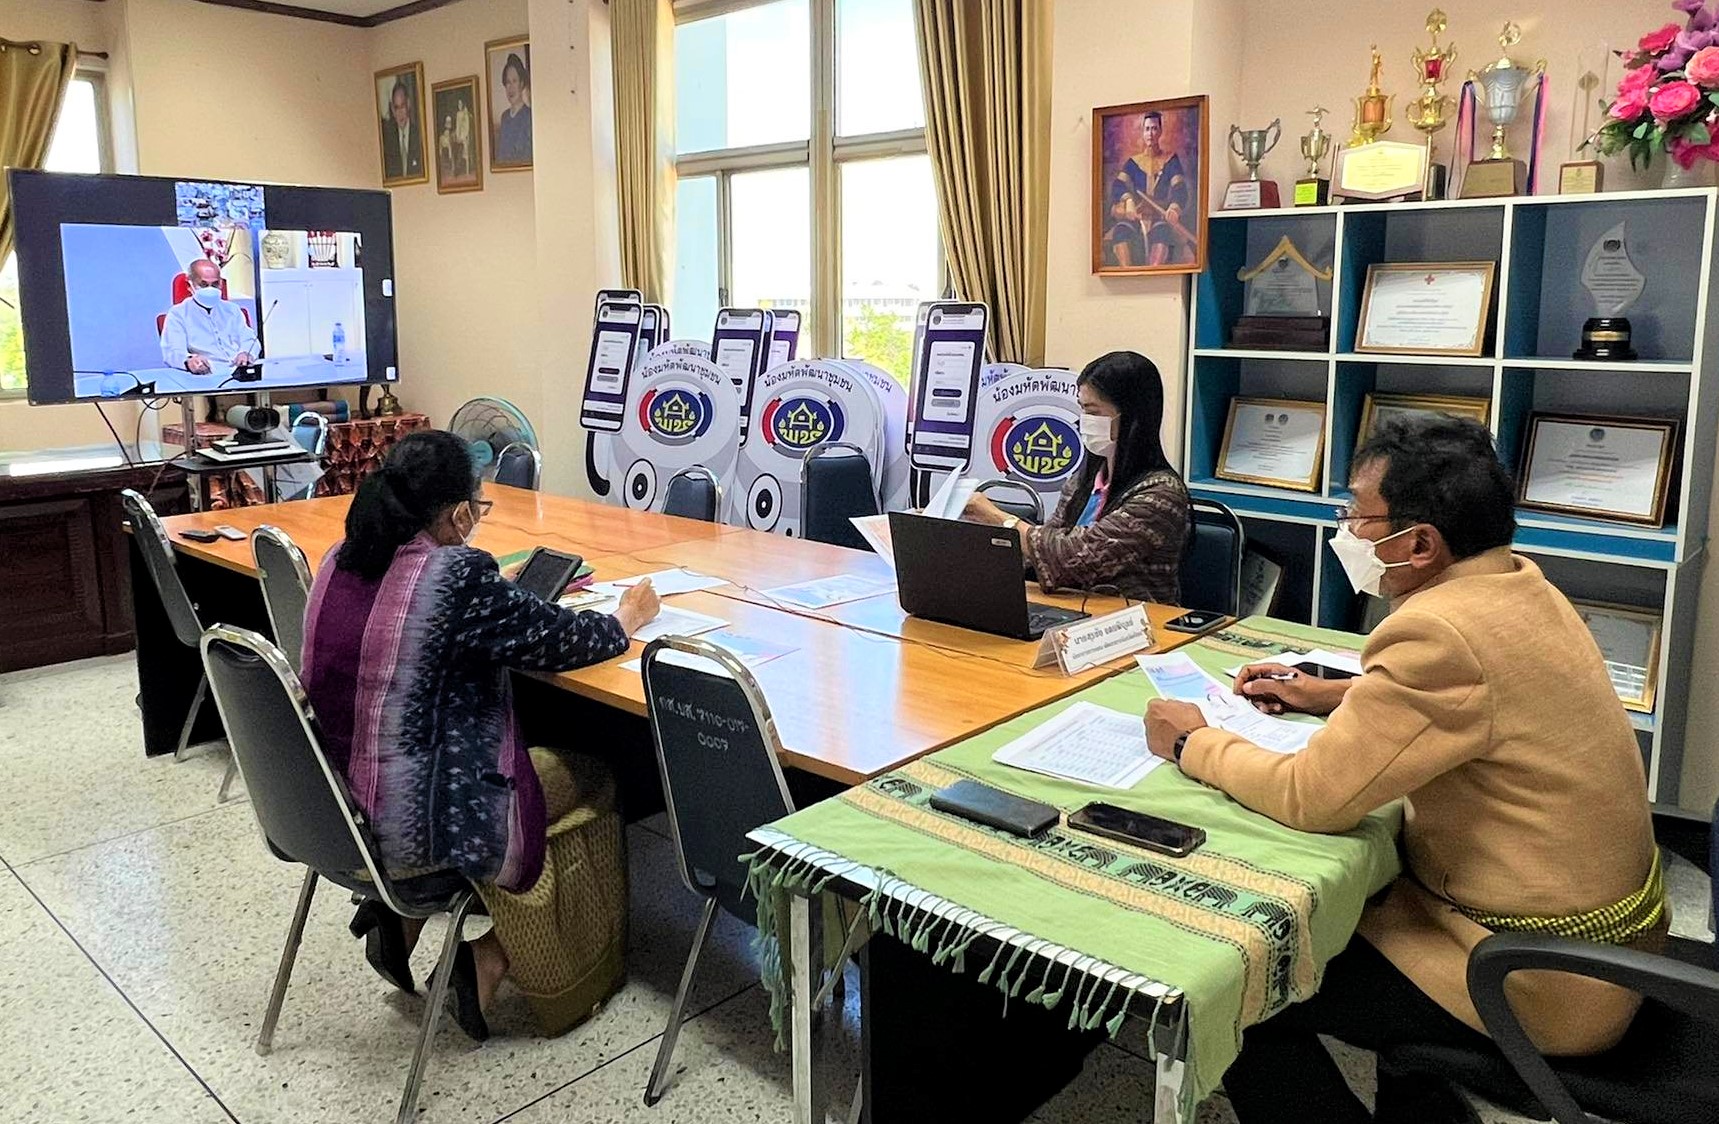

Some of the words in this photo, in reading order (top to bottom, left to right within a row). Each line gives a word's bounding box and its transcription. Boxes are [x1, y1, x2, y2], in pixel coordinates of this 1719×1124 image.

[992, 374, 1081, 403] น้องมหัดพัฒนา
